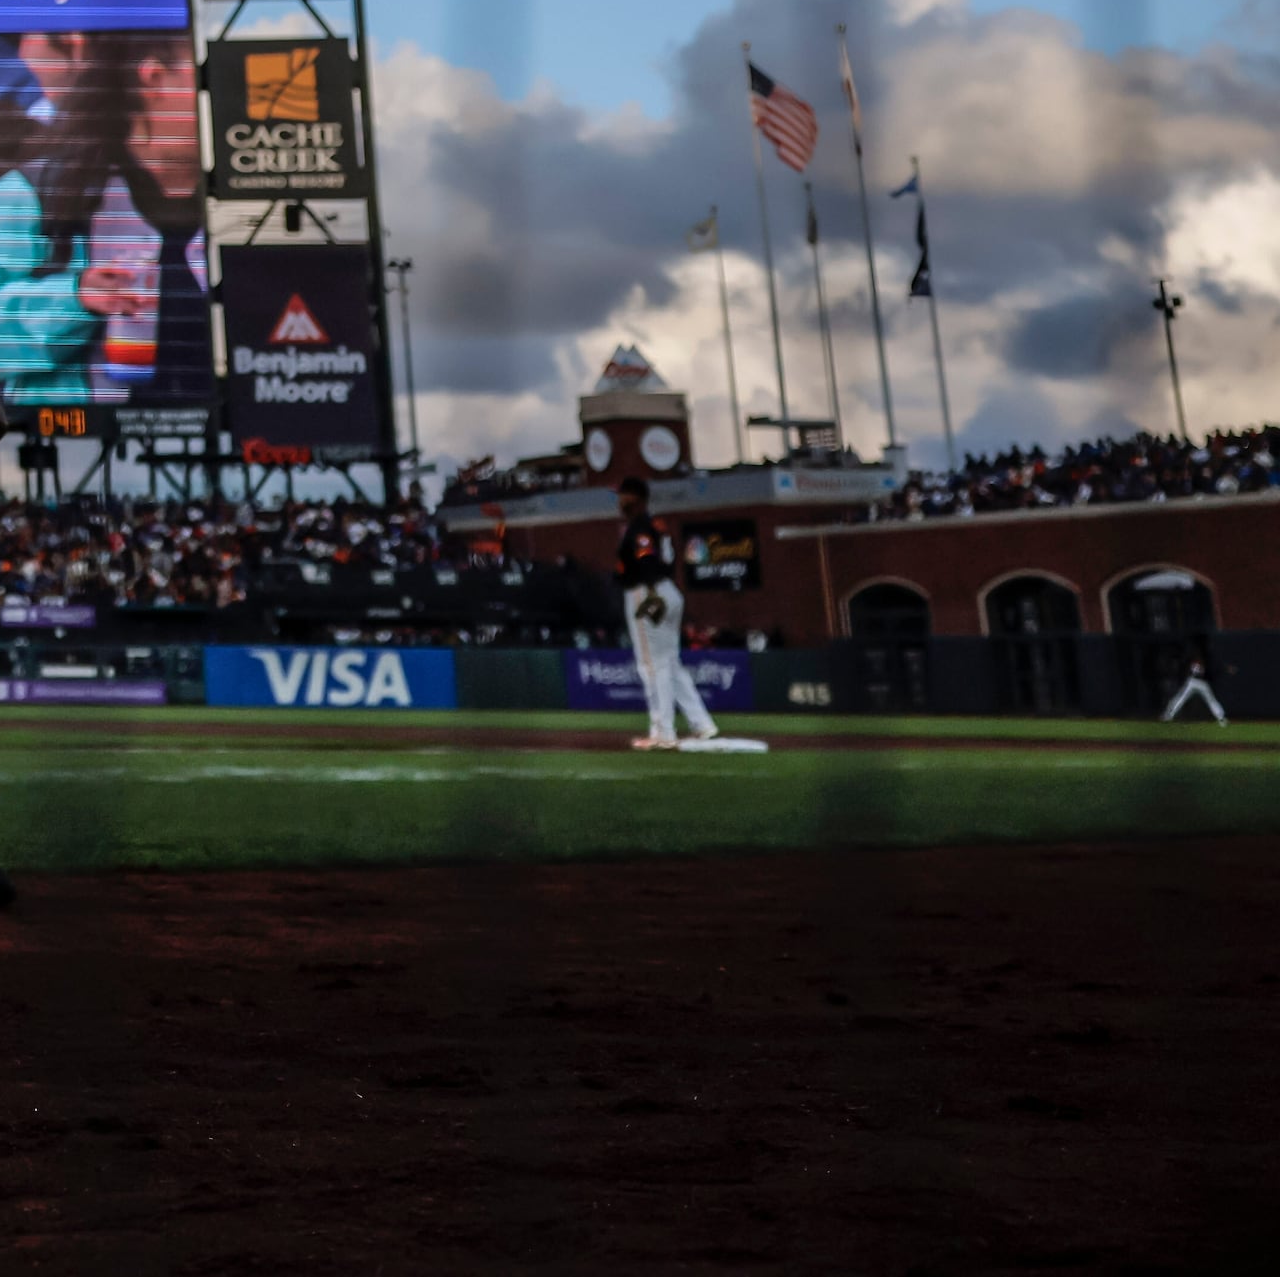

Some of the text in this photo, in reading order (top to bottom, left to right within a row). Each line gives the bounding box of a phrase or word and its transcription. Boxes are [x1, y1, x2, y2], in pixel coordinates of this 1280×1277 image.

[225, 122, 344, 149] CACHE
[229, 148, 342, 173] CREEK
[233, 345, 367, 381] Benjamin
[254, 376, 349, 404] Moore
[248, 648, 412, 707] VISA
